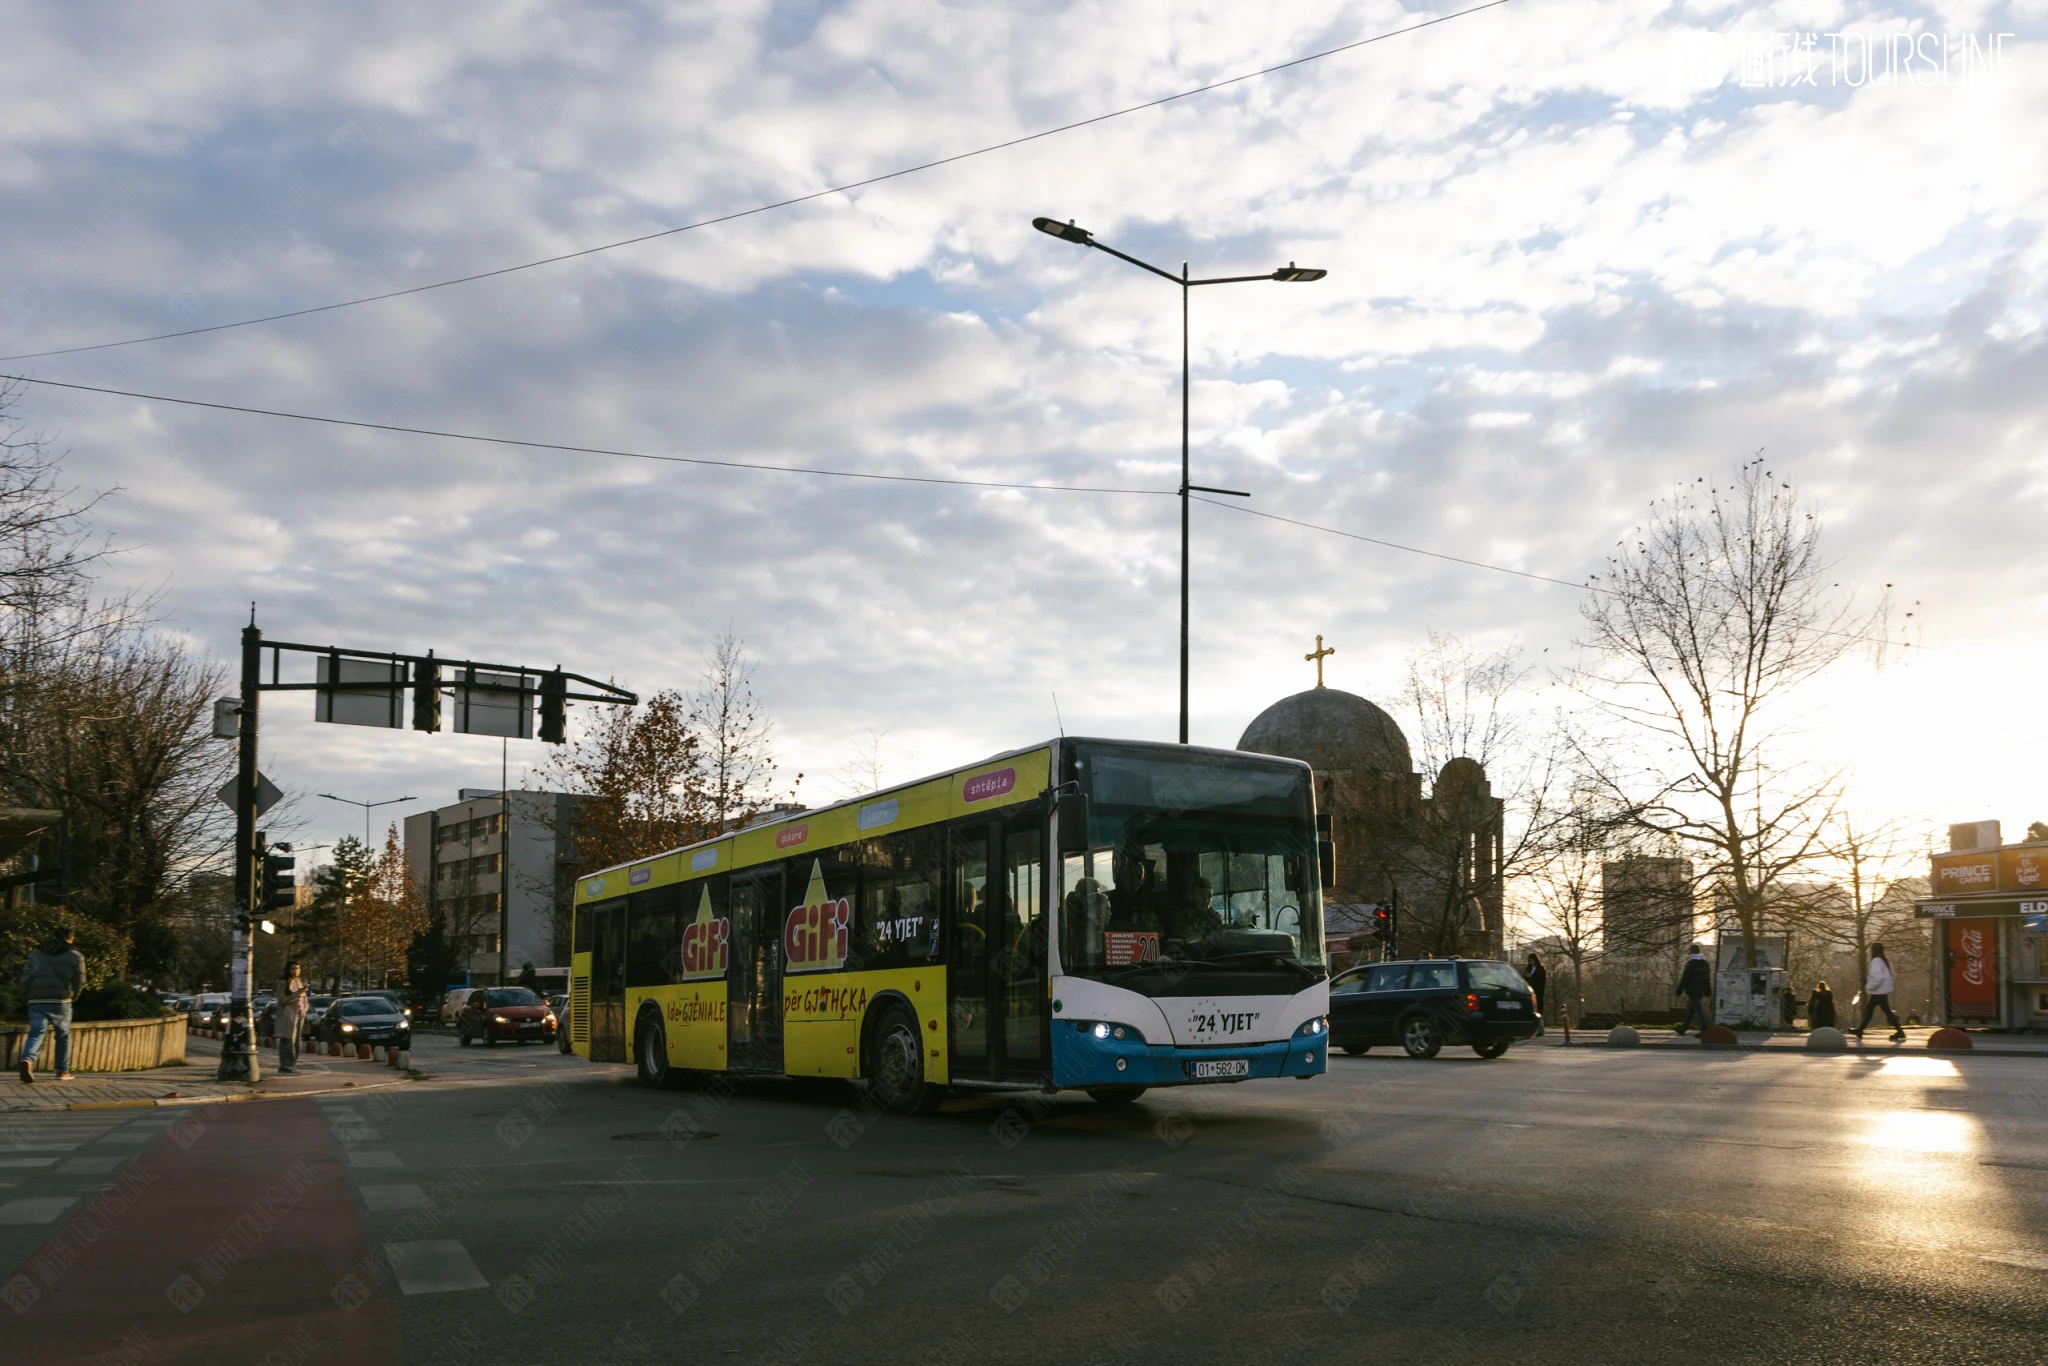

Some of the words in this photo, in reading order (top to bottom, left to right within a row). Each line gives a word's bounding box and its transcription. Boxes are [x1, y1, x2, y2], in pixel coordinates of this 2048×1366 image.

[970, 776, 1008, 795] shtëpia
[1940, 864, 1990, 879] PRINCE
[1921, 904, 1957, 914] PRINCE
[1139, 936, 1158, 963] 20
